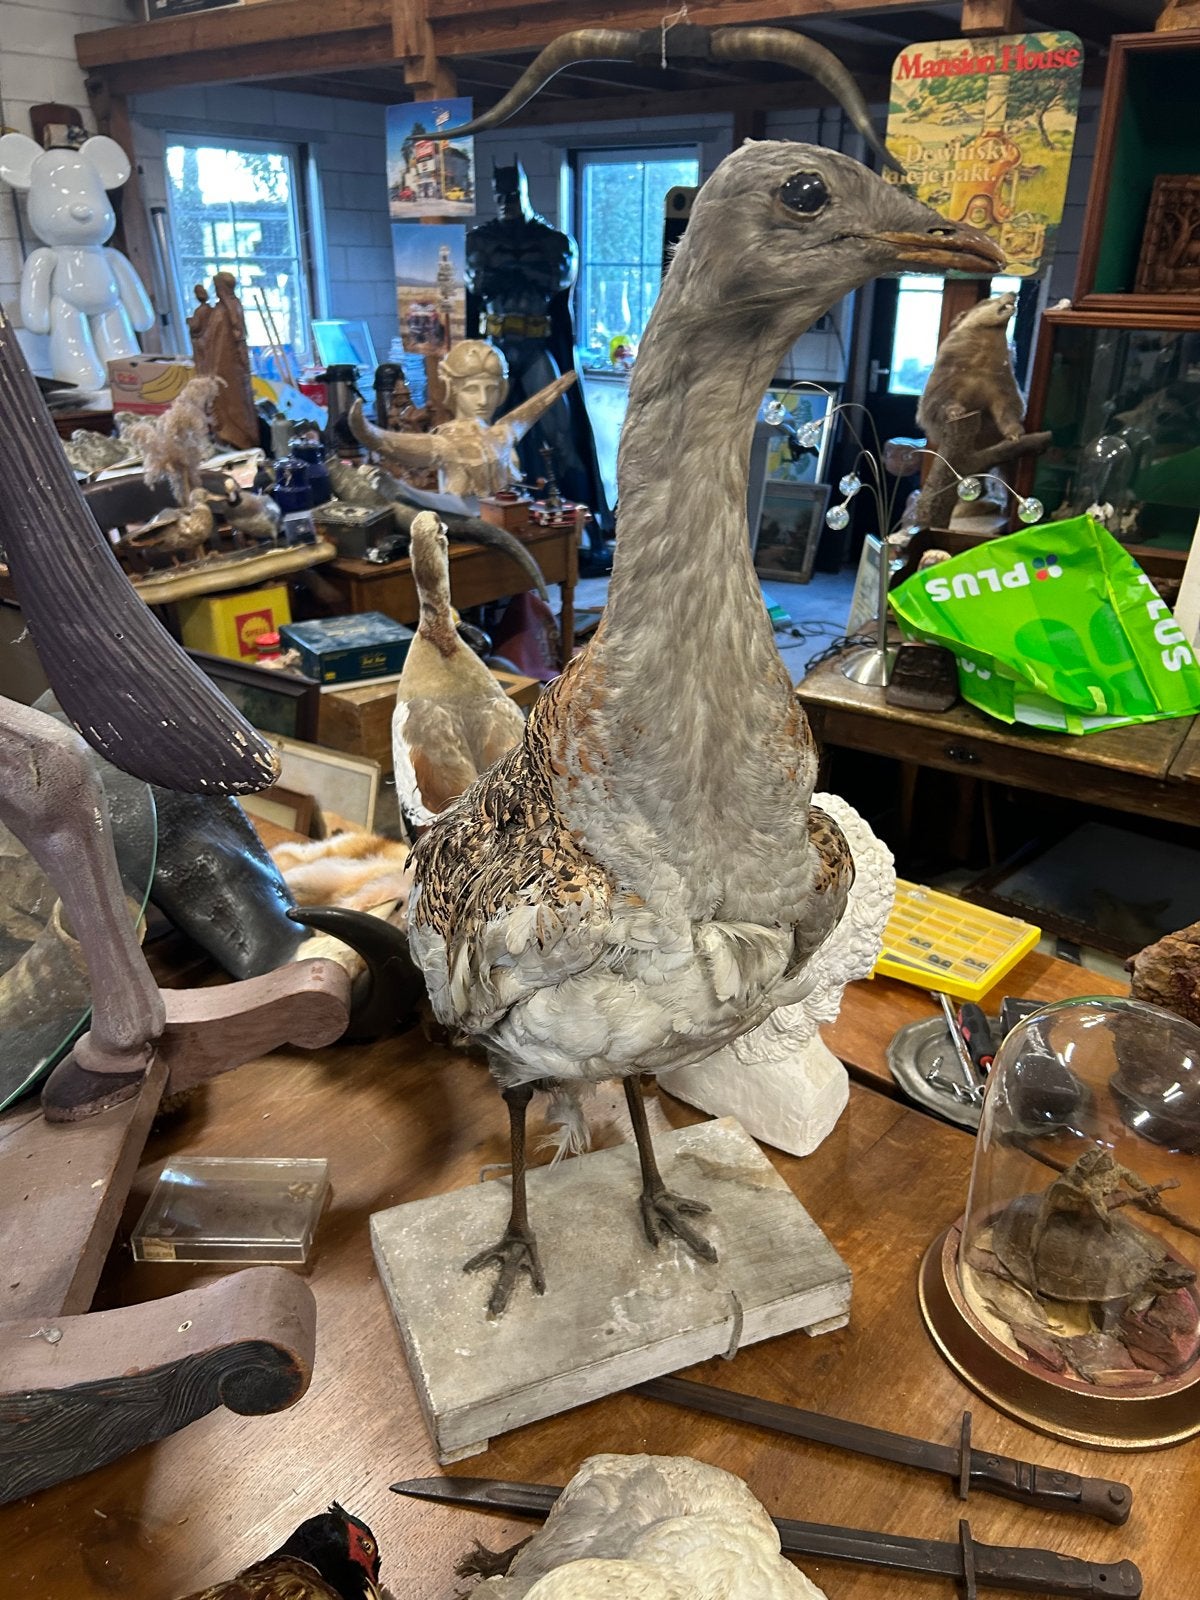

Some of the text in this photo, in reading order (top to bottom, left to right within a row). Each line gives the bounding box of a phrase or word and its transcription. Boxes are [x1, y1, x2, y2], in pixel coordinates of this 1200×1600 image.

[896, 45, 1081, 81] Mansion House
[906, 138, 1010, 163] De whisky
[941, 162, 997, 188] pakt.
[925, 562, 1031, 602] PLUS
